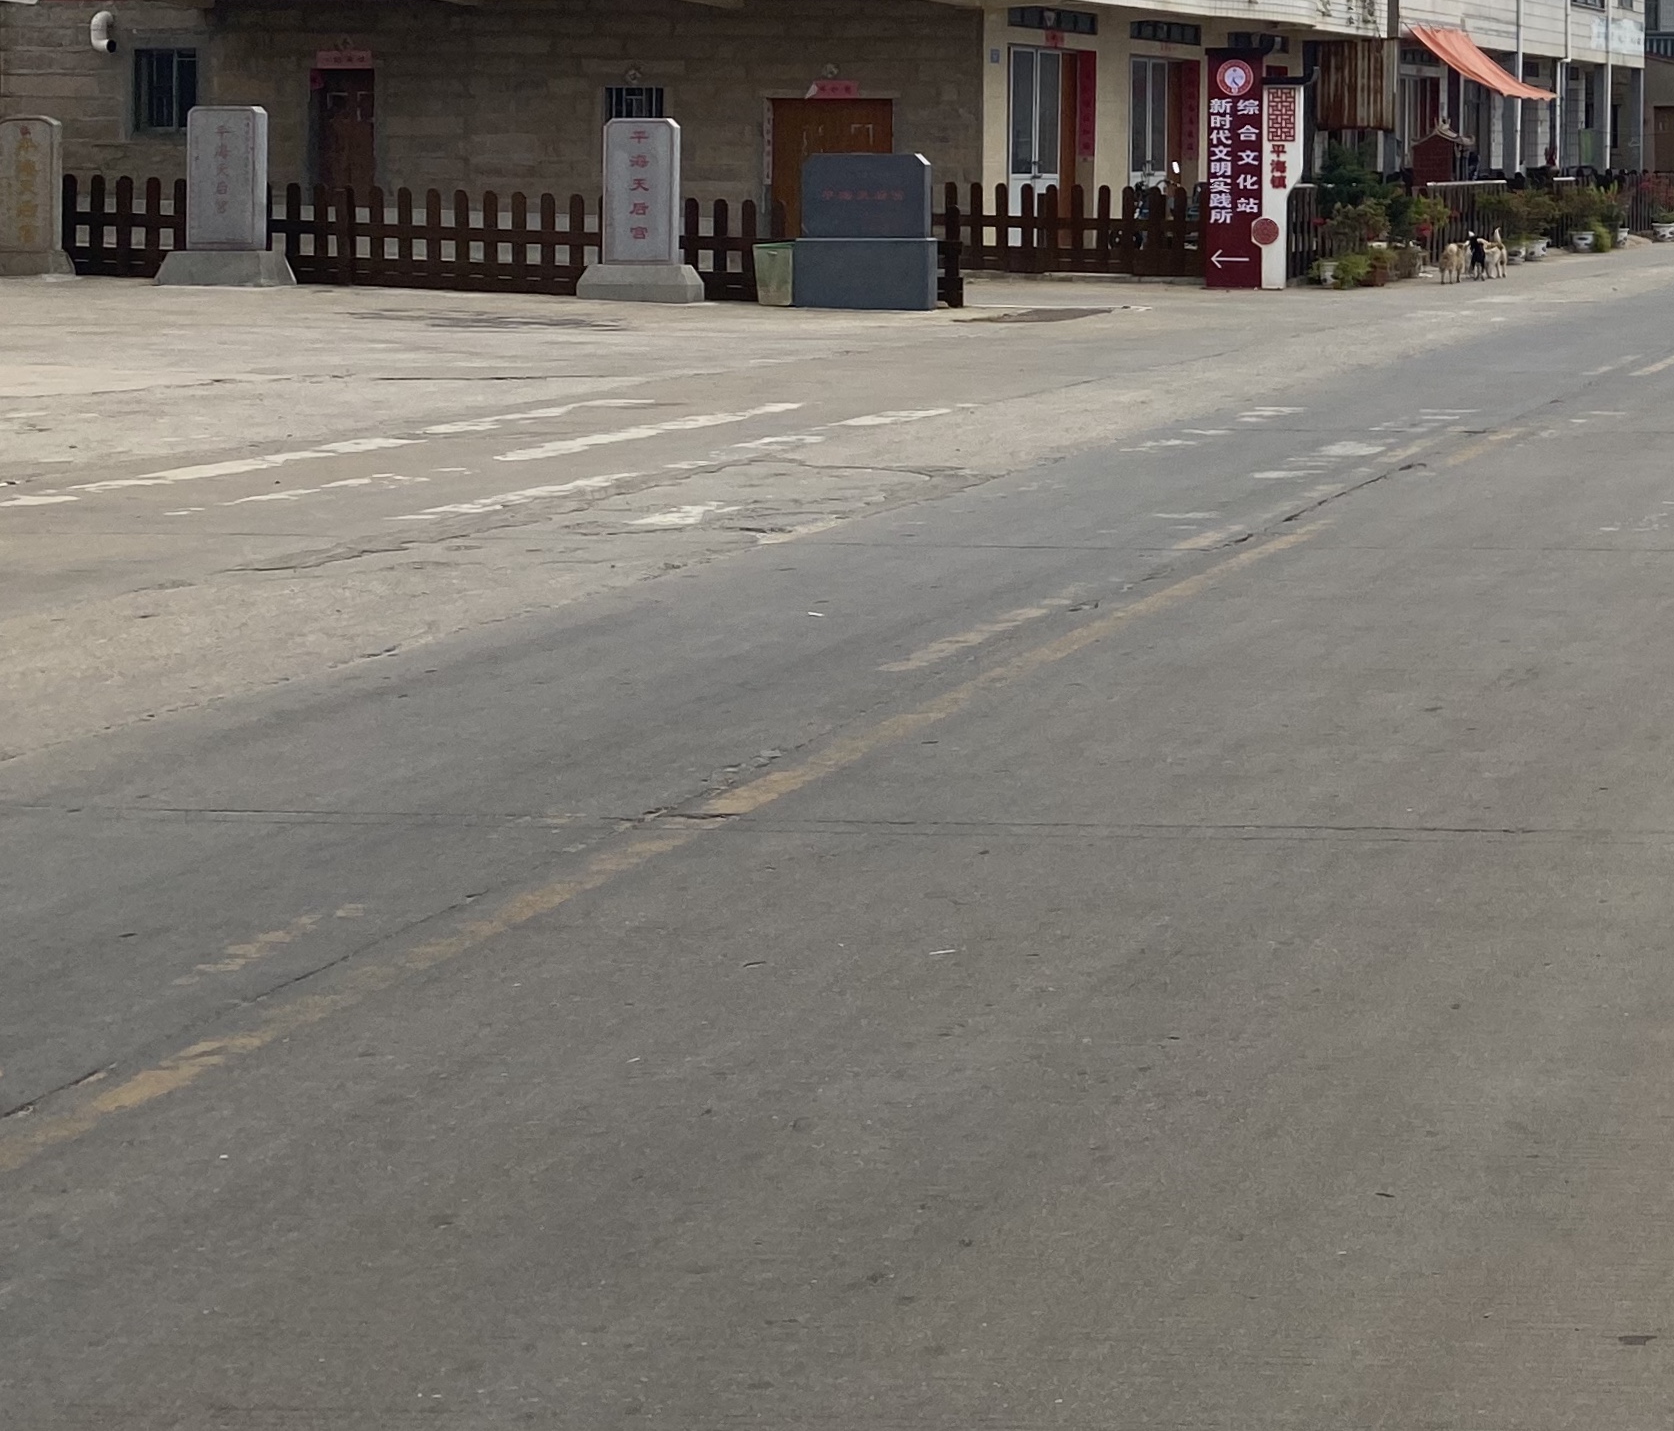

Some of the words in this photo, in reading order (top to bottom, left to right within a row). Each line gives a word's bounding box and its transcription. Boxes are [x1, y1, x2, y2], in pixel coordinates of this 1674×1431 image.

[1208, 97, 1233, 225] 新时代文明实践所
[1236, 98, 1260, 214] 综合文化站
[1269, 143, 1288, 190] 平海镇
